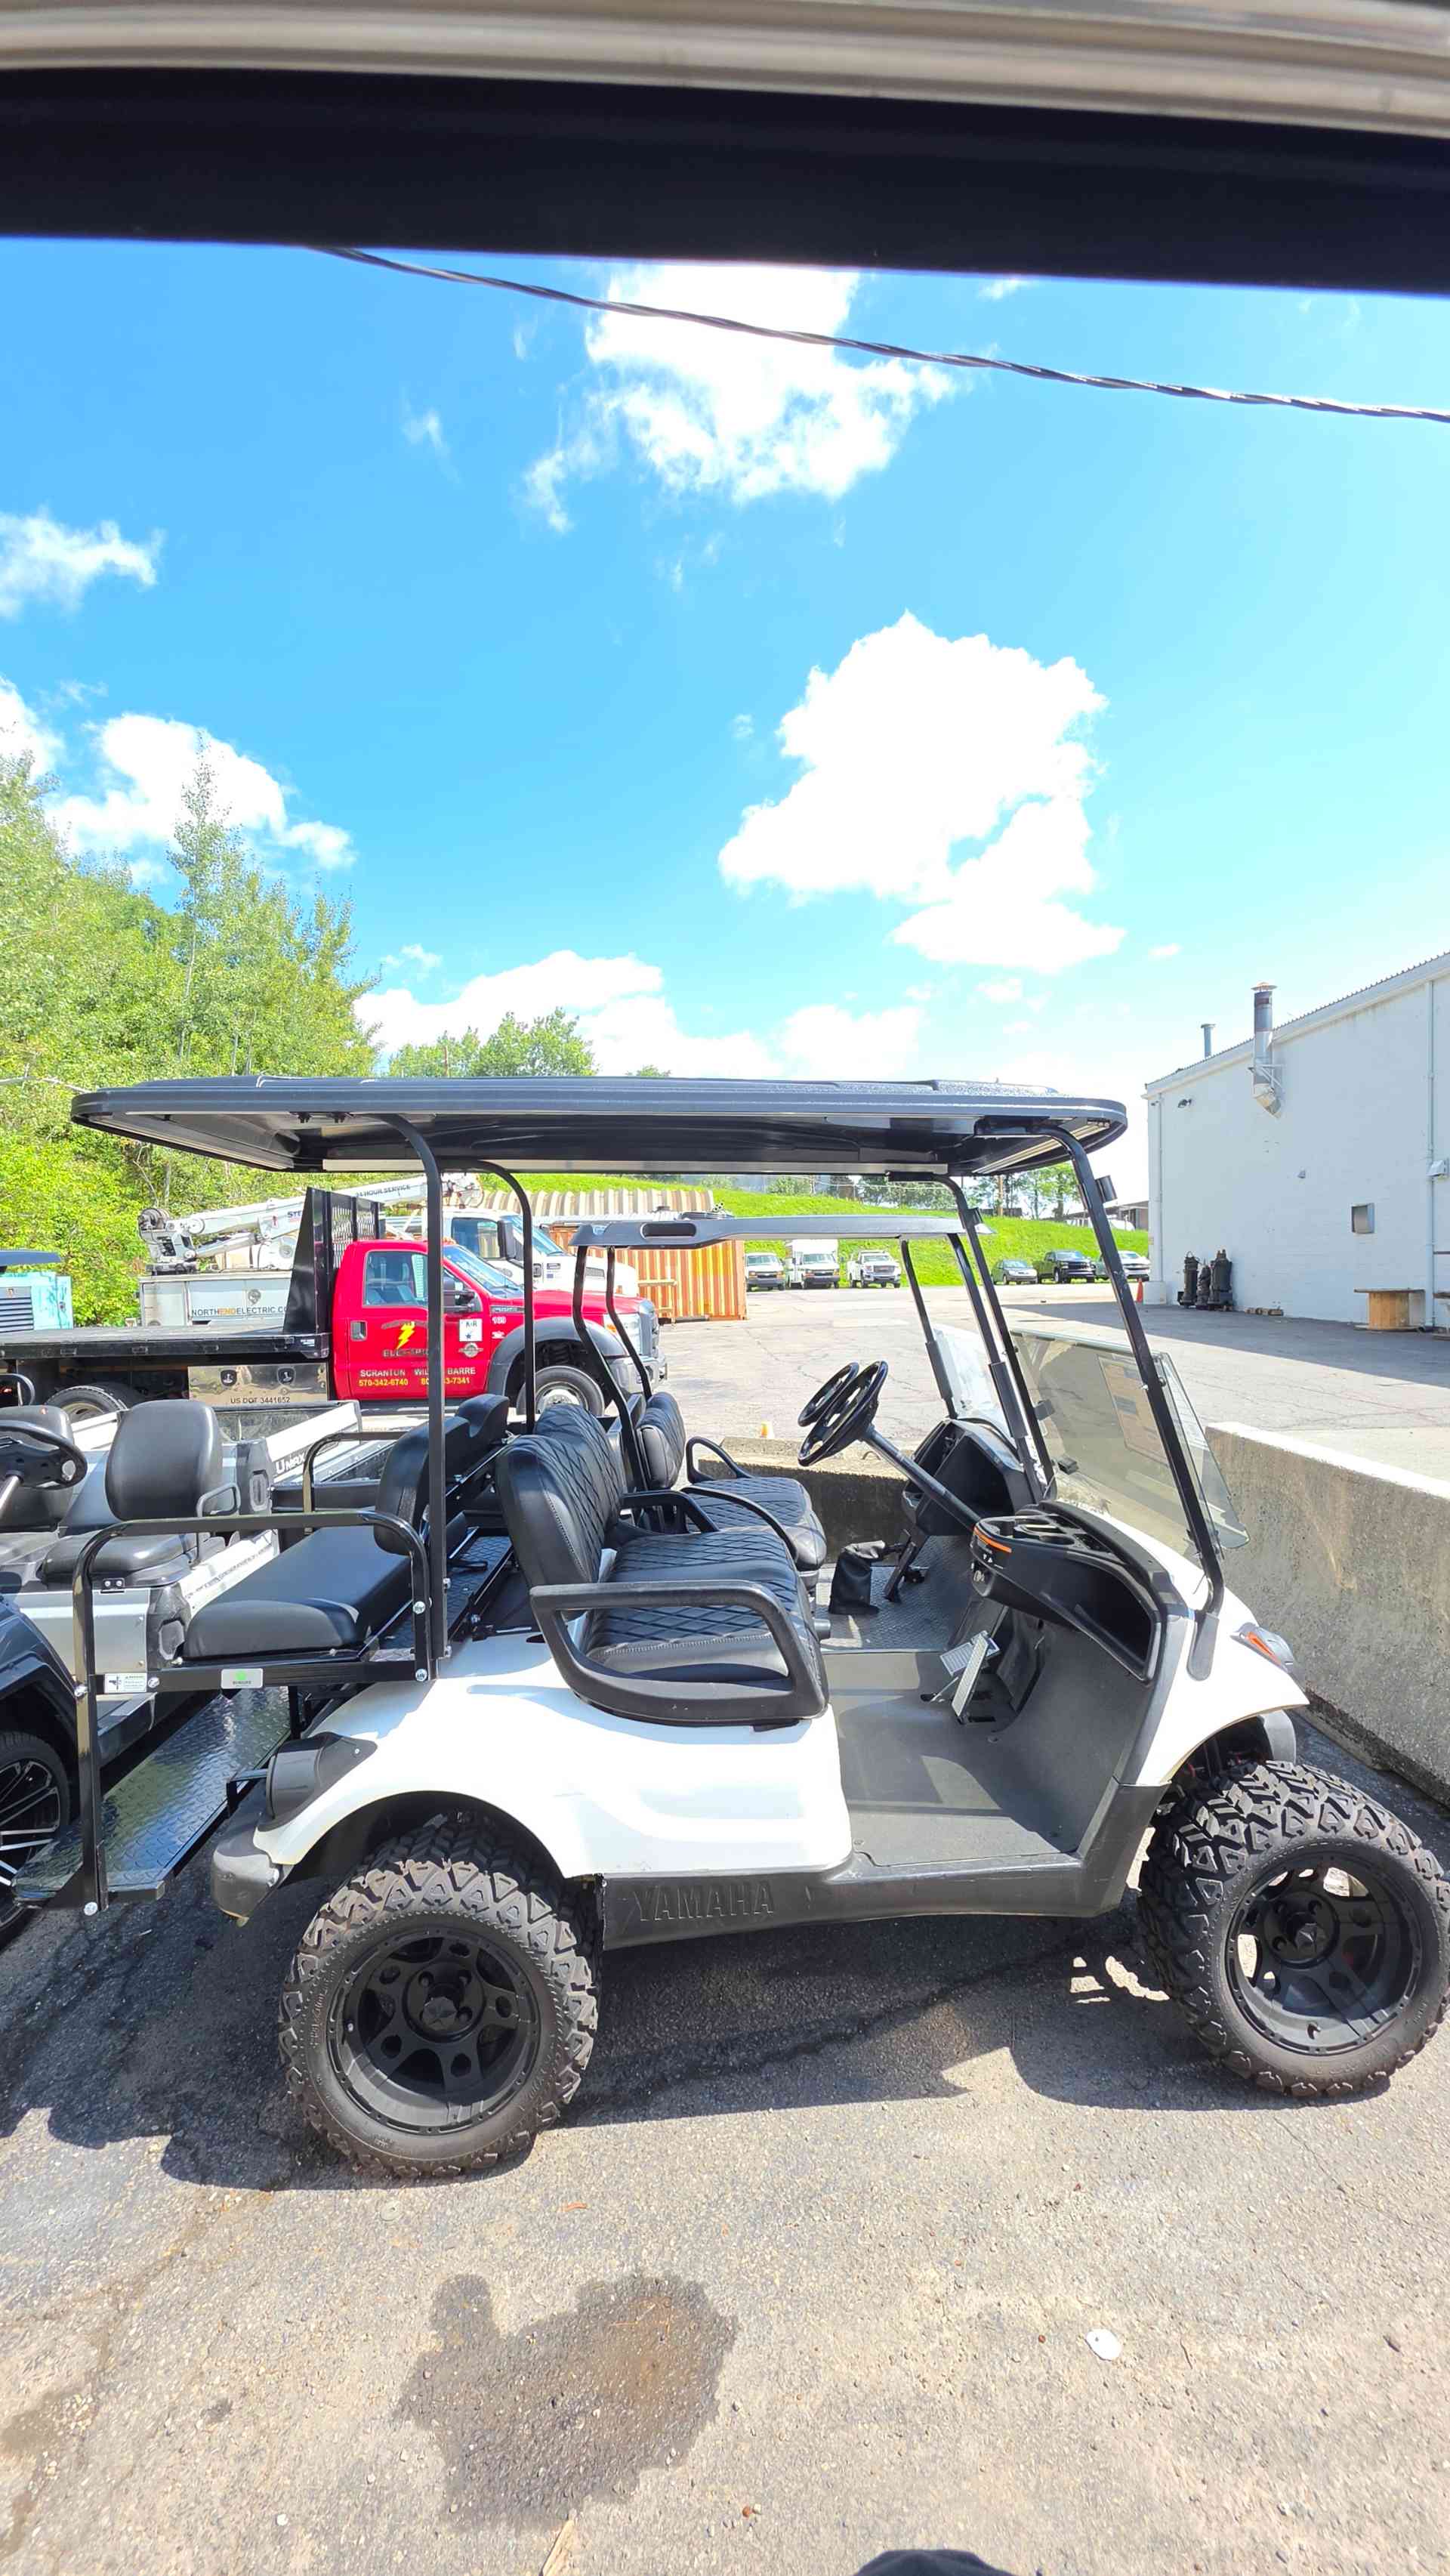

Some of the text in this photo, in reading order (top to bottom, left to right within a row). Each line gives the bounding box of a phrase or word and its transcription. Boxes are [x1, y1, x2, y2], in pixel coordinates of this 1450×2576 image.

[384, 1185, 411, 1194] SERVICE
[359, 1369, 406, 1378] SCRANTON
[447, 1367, 477, 1376] BARRE
[633, 1881, 773, 1921] YAMAHA
